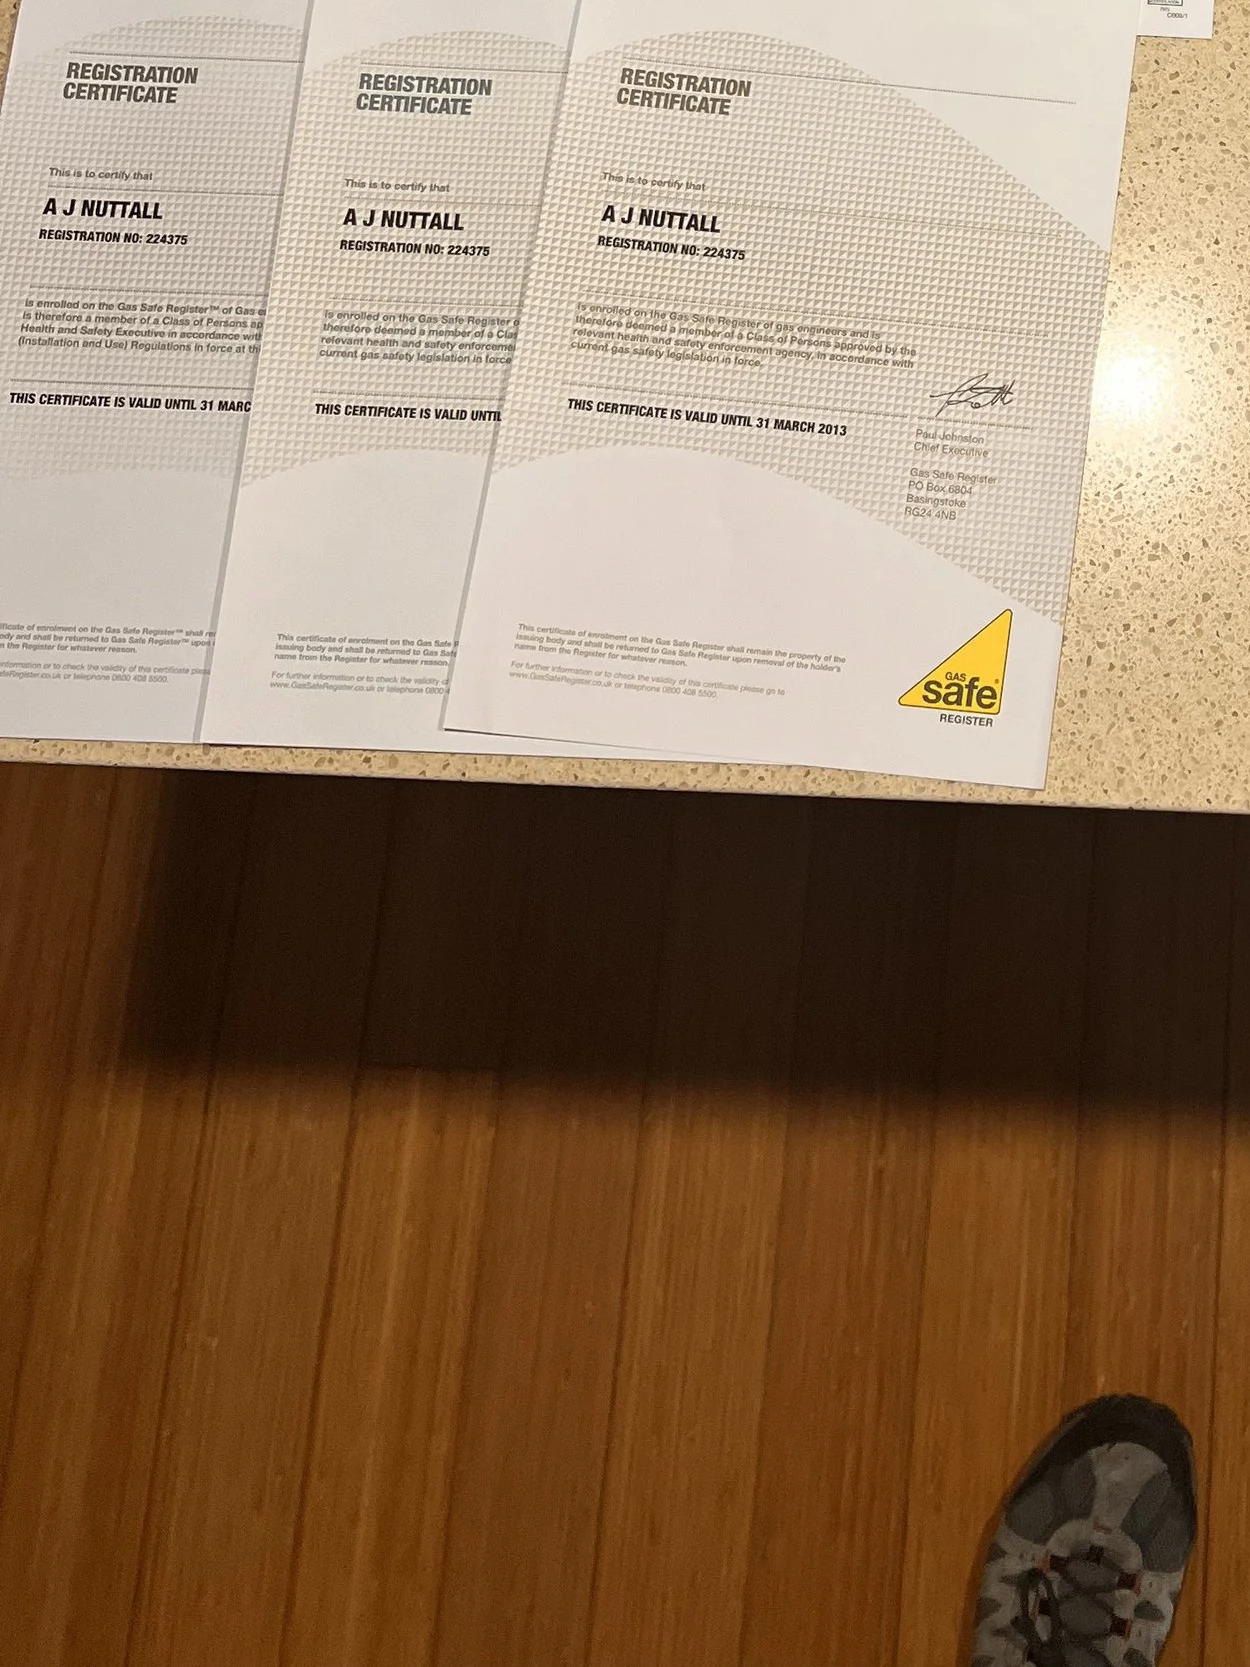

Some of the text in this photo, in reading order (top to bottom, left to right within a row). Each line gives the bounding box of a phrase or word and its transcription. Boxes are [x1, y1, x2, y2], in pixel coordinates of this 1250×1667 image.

[65, 60, 199, 84] REGISTRATION
[619, 66, 752, 98] REGISTRATION
[62, 81, 179, 104] CERTIFICATE
[615, 86, 732, 116] CERTIFICATE
[41, 196, 163, 220] A J NUTTALL
[600, 203, 721, 234] A J NUTTALL
[566, 397, 848, 437] THIS CERTIFICATE IS VALID UNTIL 31 MARCH 2013
[943, 670, 967, 683] GAS
[922, 677, 997, 709] safe
[938, 712, 994, 728] REGISTER
